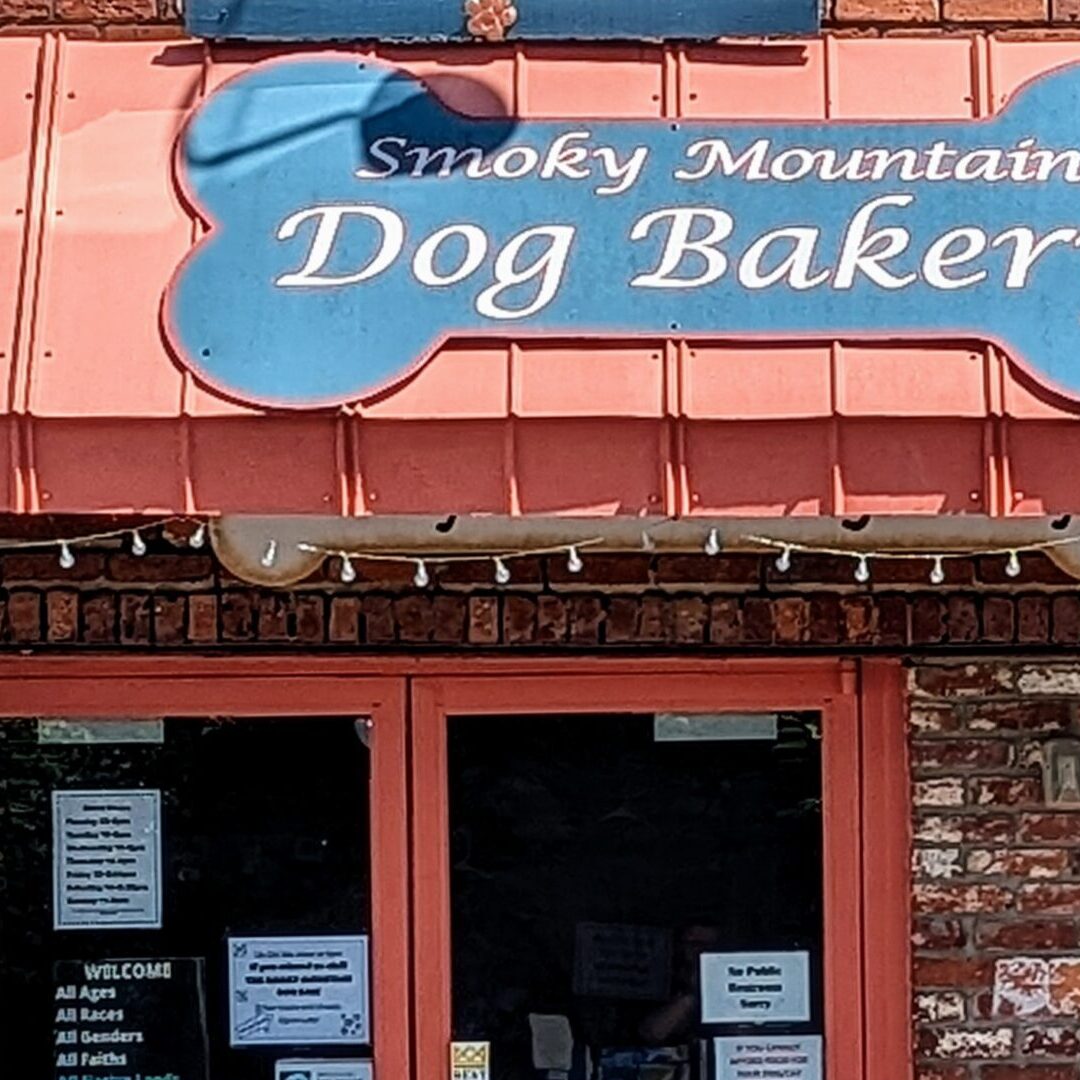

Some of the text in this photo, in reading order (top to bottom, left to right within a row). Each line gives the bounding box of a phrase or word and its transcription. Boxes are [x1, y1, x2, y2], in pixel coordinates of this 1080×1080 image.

[356, 131, 649, 196] Smoky
[274, 201, 577, 322] Dog
[84, 962, 171, 980] WELCOME
[55, 985, 116, 1003] All Ages
[55, 1008, 124, 1022] All Races
[55, 1029, 144, 1045] All Genders
[57, 1053, 77, 1066] All
